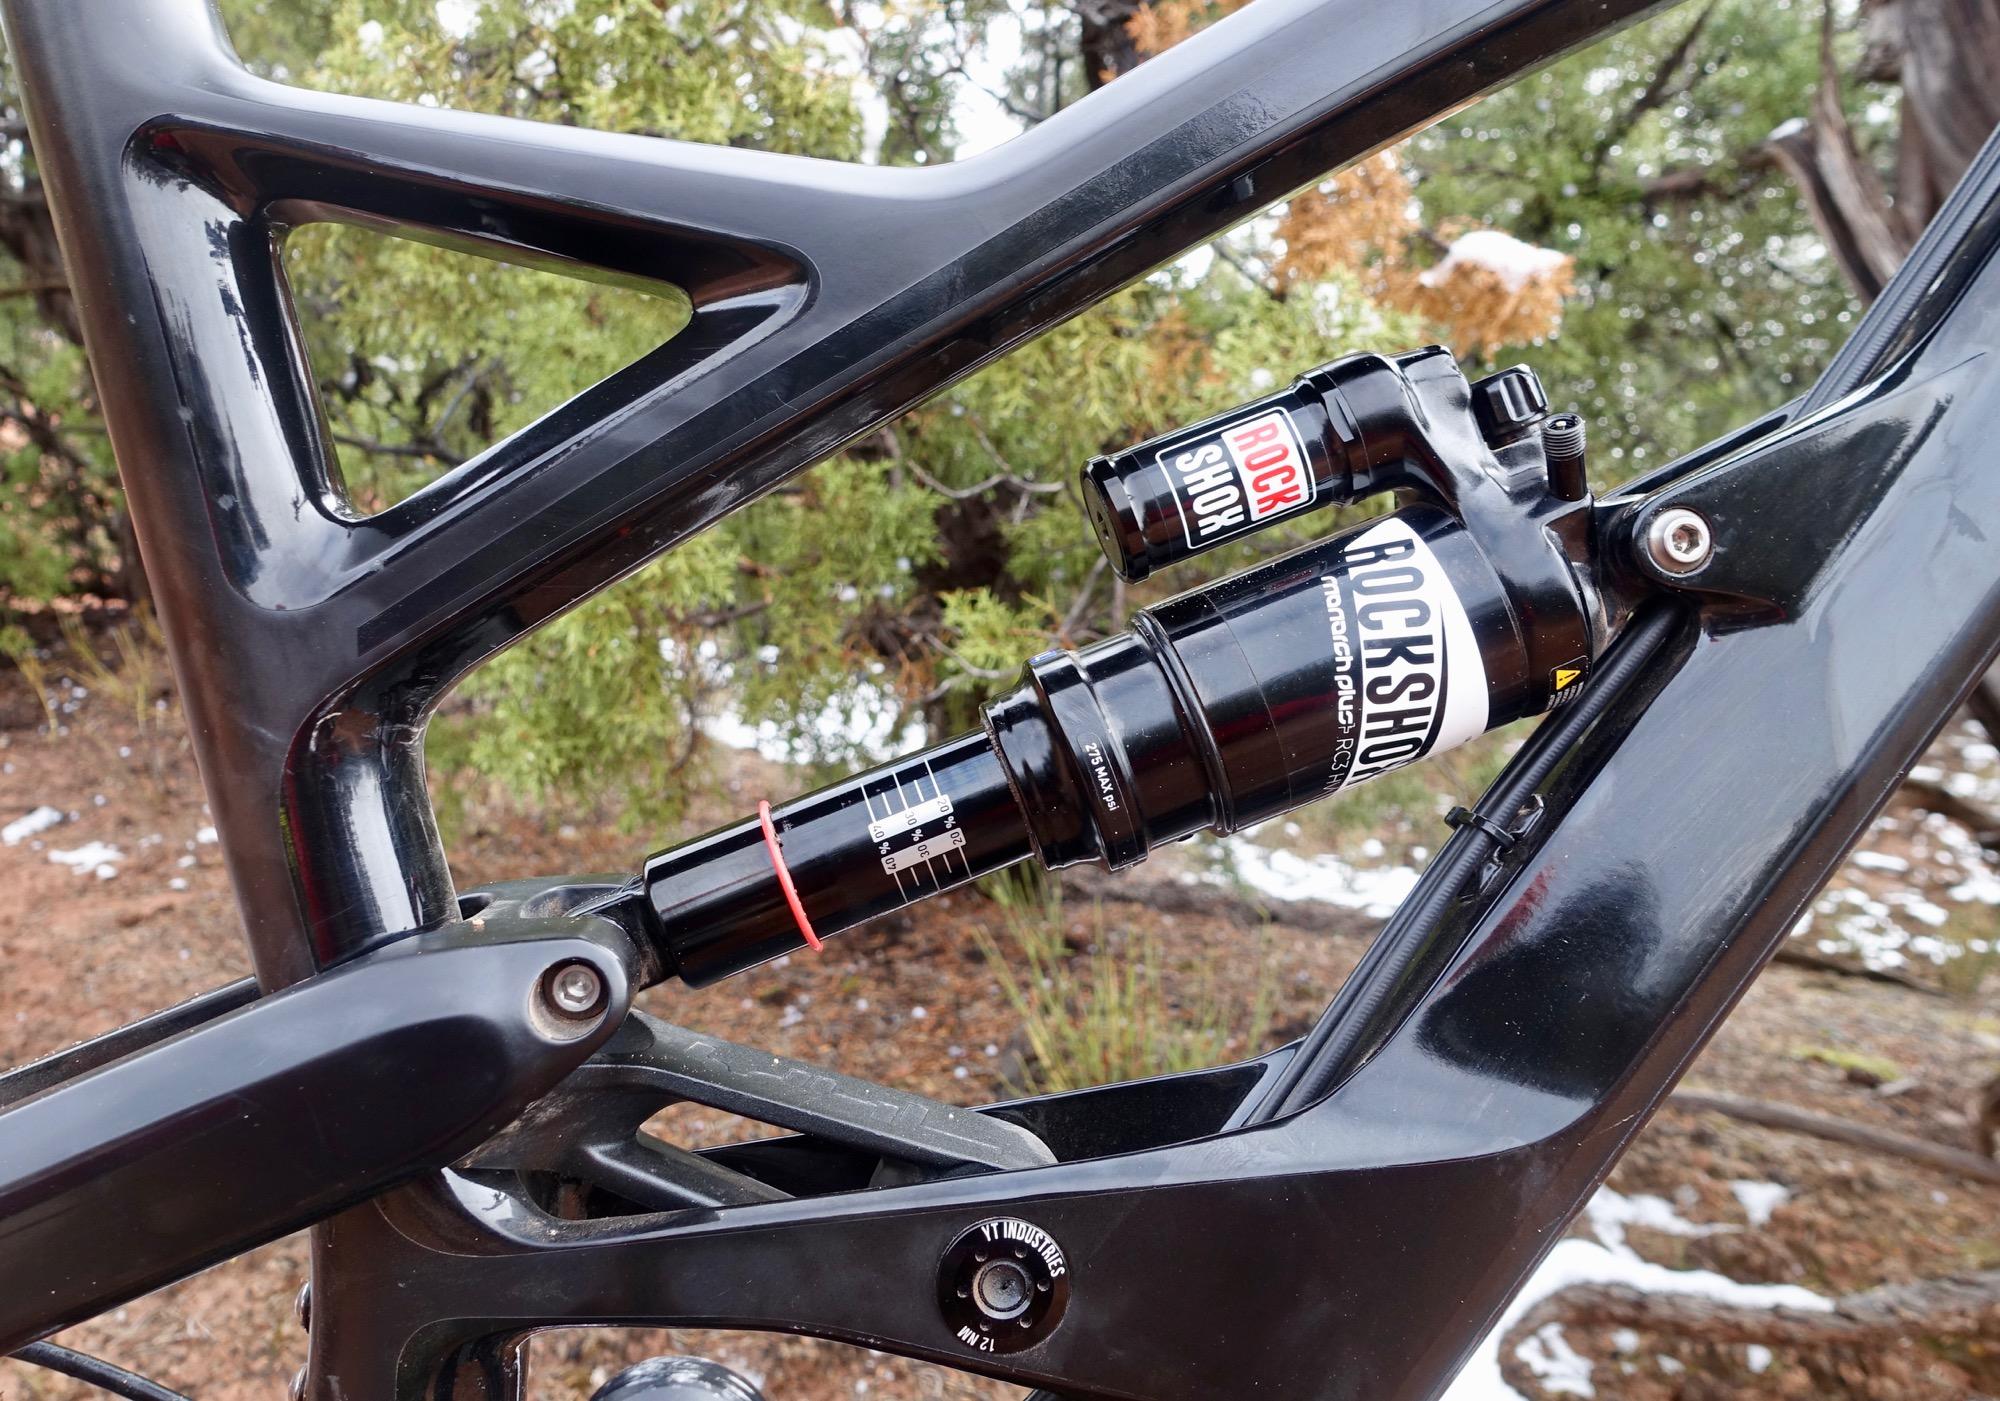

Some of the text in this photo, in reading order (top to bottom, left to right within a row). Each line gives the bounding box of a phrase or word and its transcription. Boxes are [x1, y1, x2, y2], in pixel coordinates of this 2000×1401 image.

[1175, 444, 1245, 536] SHOX
[1233, 422, 1301, 514] ROCK
[1320, 575, 1354, 673] monarch
[1085, 742, 1120, 812] 275 MAX psi
[1331, 738, 1354, 771] RC3
[981, 1221, 1066, 1278] YT INDUSTRIES
[956, 1325, 995, 1353] 12 NM
